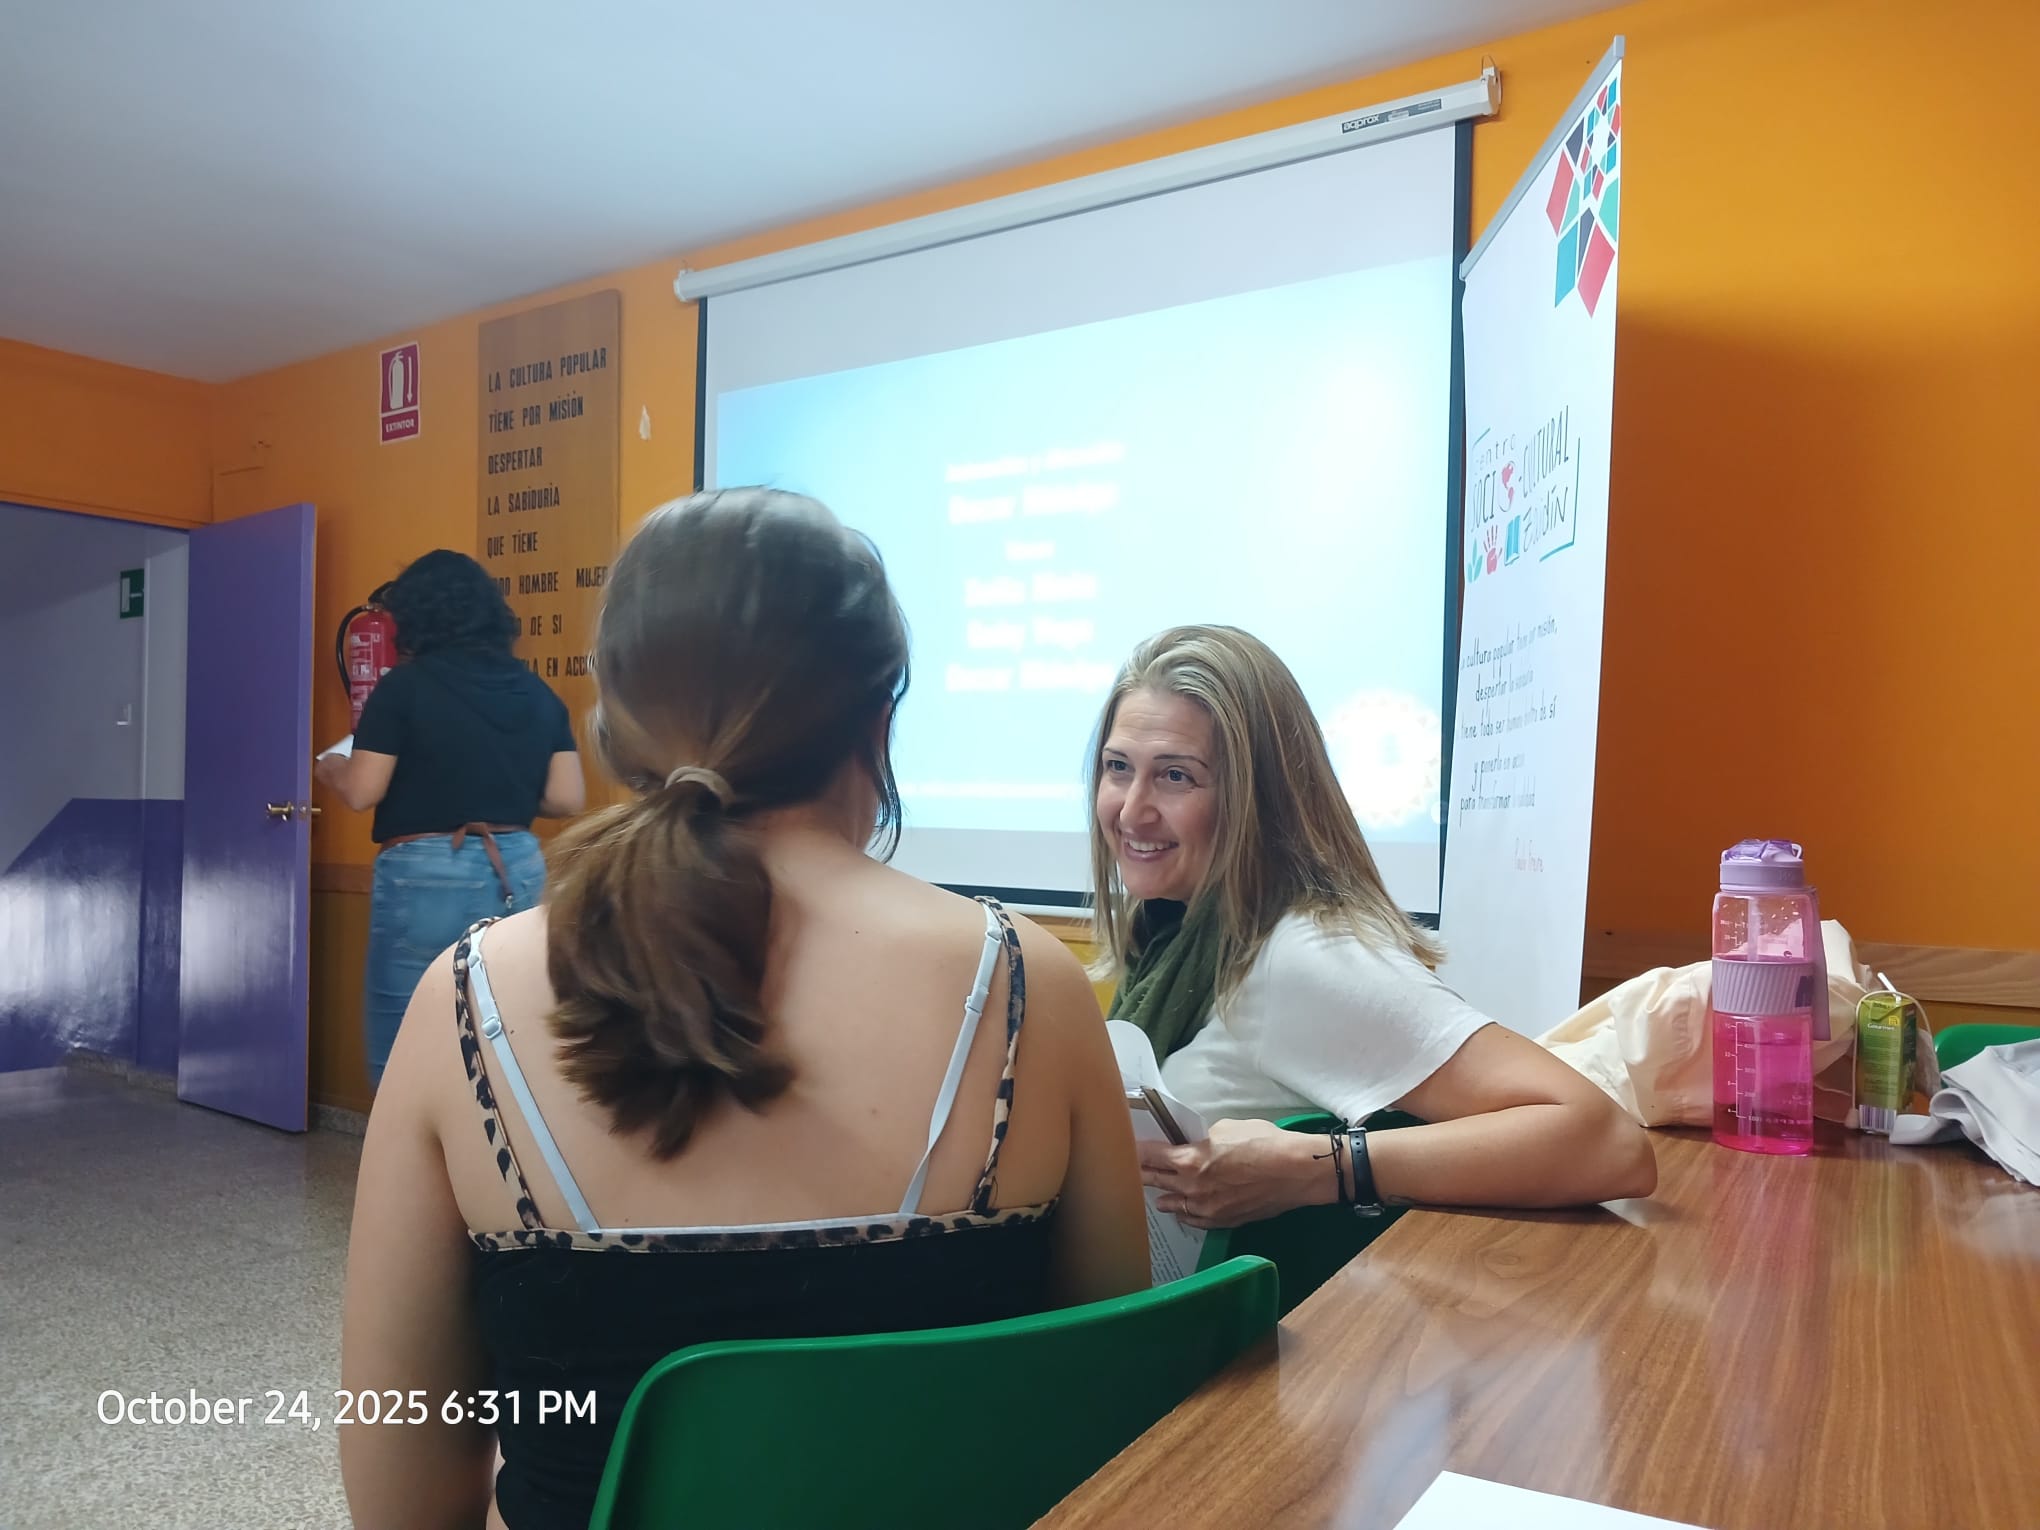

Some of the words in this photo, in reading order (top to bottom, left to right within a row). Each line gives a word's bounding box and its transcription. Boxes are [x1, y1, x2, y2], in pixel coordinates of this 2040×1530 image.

[488, 371, 501, 393] LA
[510, 360, 552, 389] CULTURA
[560, 347, 606, 377] POPULAR
[385, 418, 415, 433] EXTINTOR
[489, 408, 514, 433] TIENE
[522, 405, 541, 427] POR
[488, 446, 543, 474] DESPERTAR
[487, 495, 500, 516] LA
[487, 536, 504, 559] QUE
[512, 529, 538, 554] TIENE
[518, 571, 559, 595] HOMBRE
[530, 615, 542, 636] DE
[546, 657, 558, 678] EN
